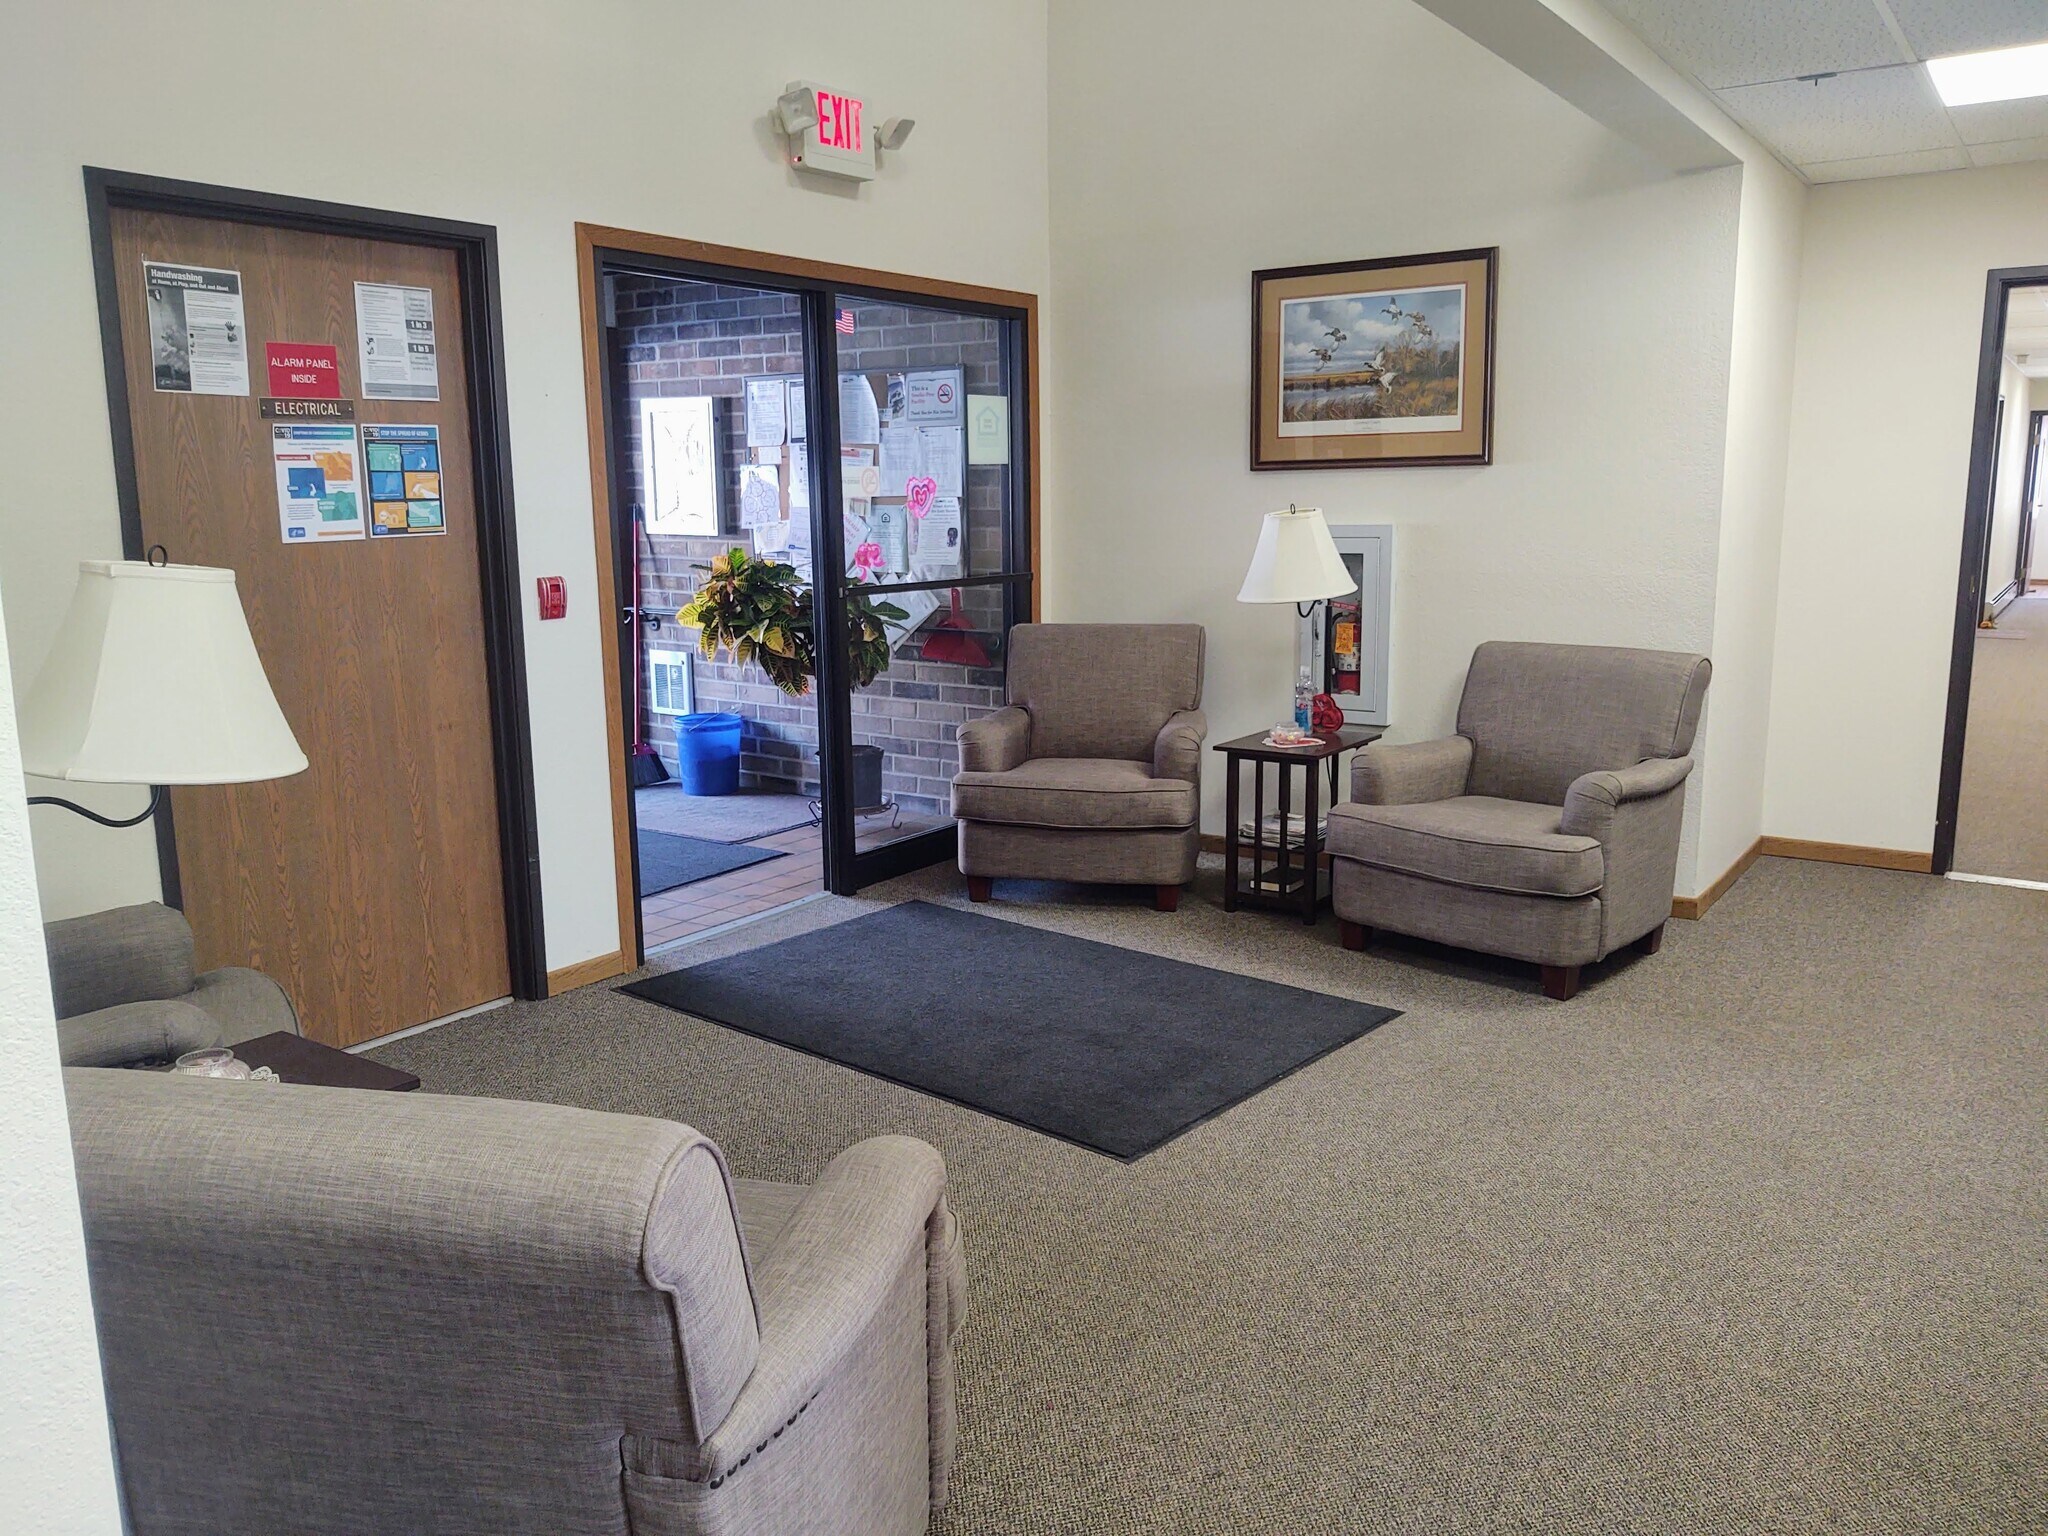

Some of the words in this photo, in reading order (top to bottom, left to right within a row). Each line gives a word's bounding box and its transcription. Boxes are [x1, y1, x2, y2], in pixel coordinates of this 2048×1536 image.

[817, 91, 863, 152] EXIT
[151, 269, 203, 283] Handwashing
[422, 321, 427, 329] 3
[271, 357, 305, 368] ALARM
[306, 358, 334, 370] PANEL
[291, 373, 318, 384] INSIDE
[274, 402, 342, 416] ELECTRICAL
